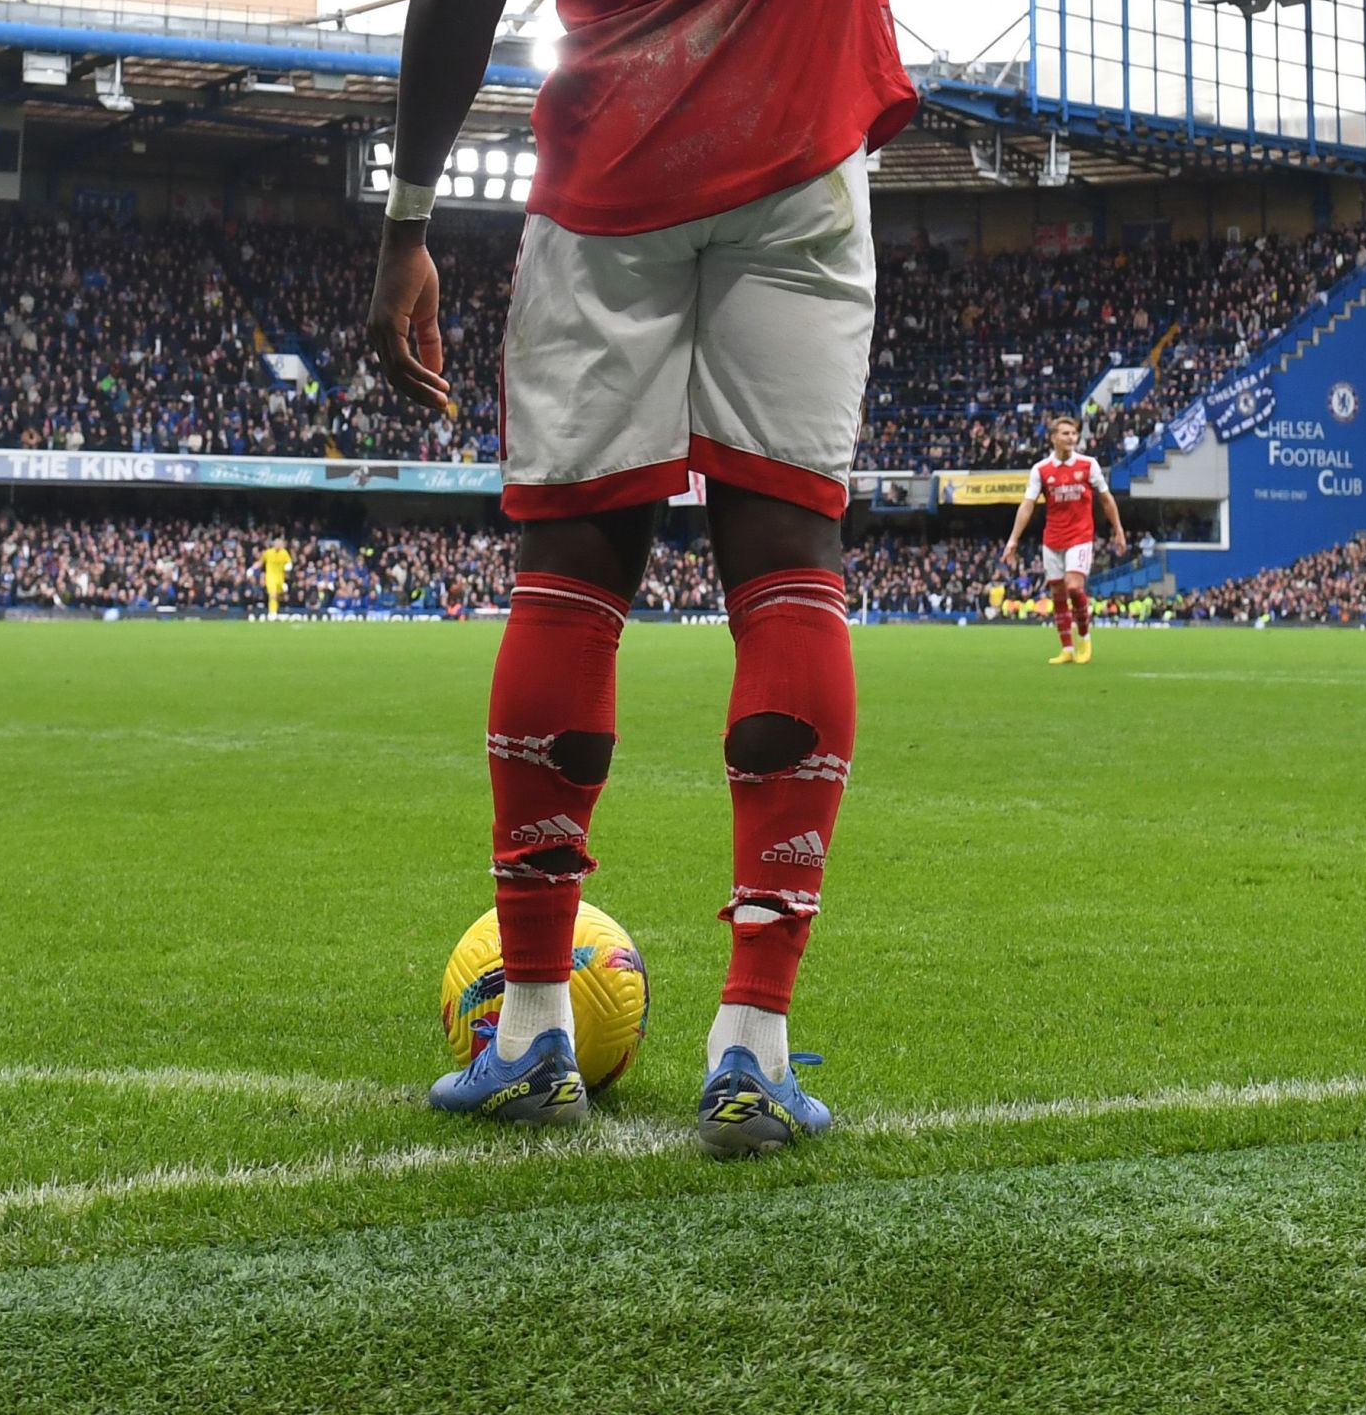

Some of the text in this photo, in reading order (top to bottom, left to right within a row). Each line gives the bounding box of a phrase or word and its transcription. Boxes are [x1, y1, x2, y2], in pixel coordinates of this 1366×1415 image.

[1206, 373, 1258, 406] CHELSEA
[1269, 440, 1353, 468] FOOTBALL
[8, 455, 69, 480] THE
[80, 457, 155, 481] KING
[1318, 469, 1363, 496] CLUB
[761, 850, 826, 869] adidas
